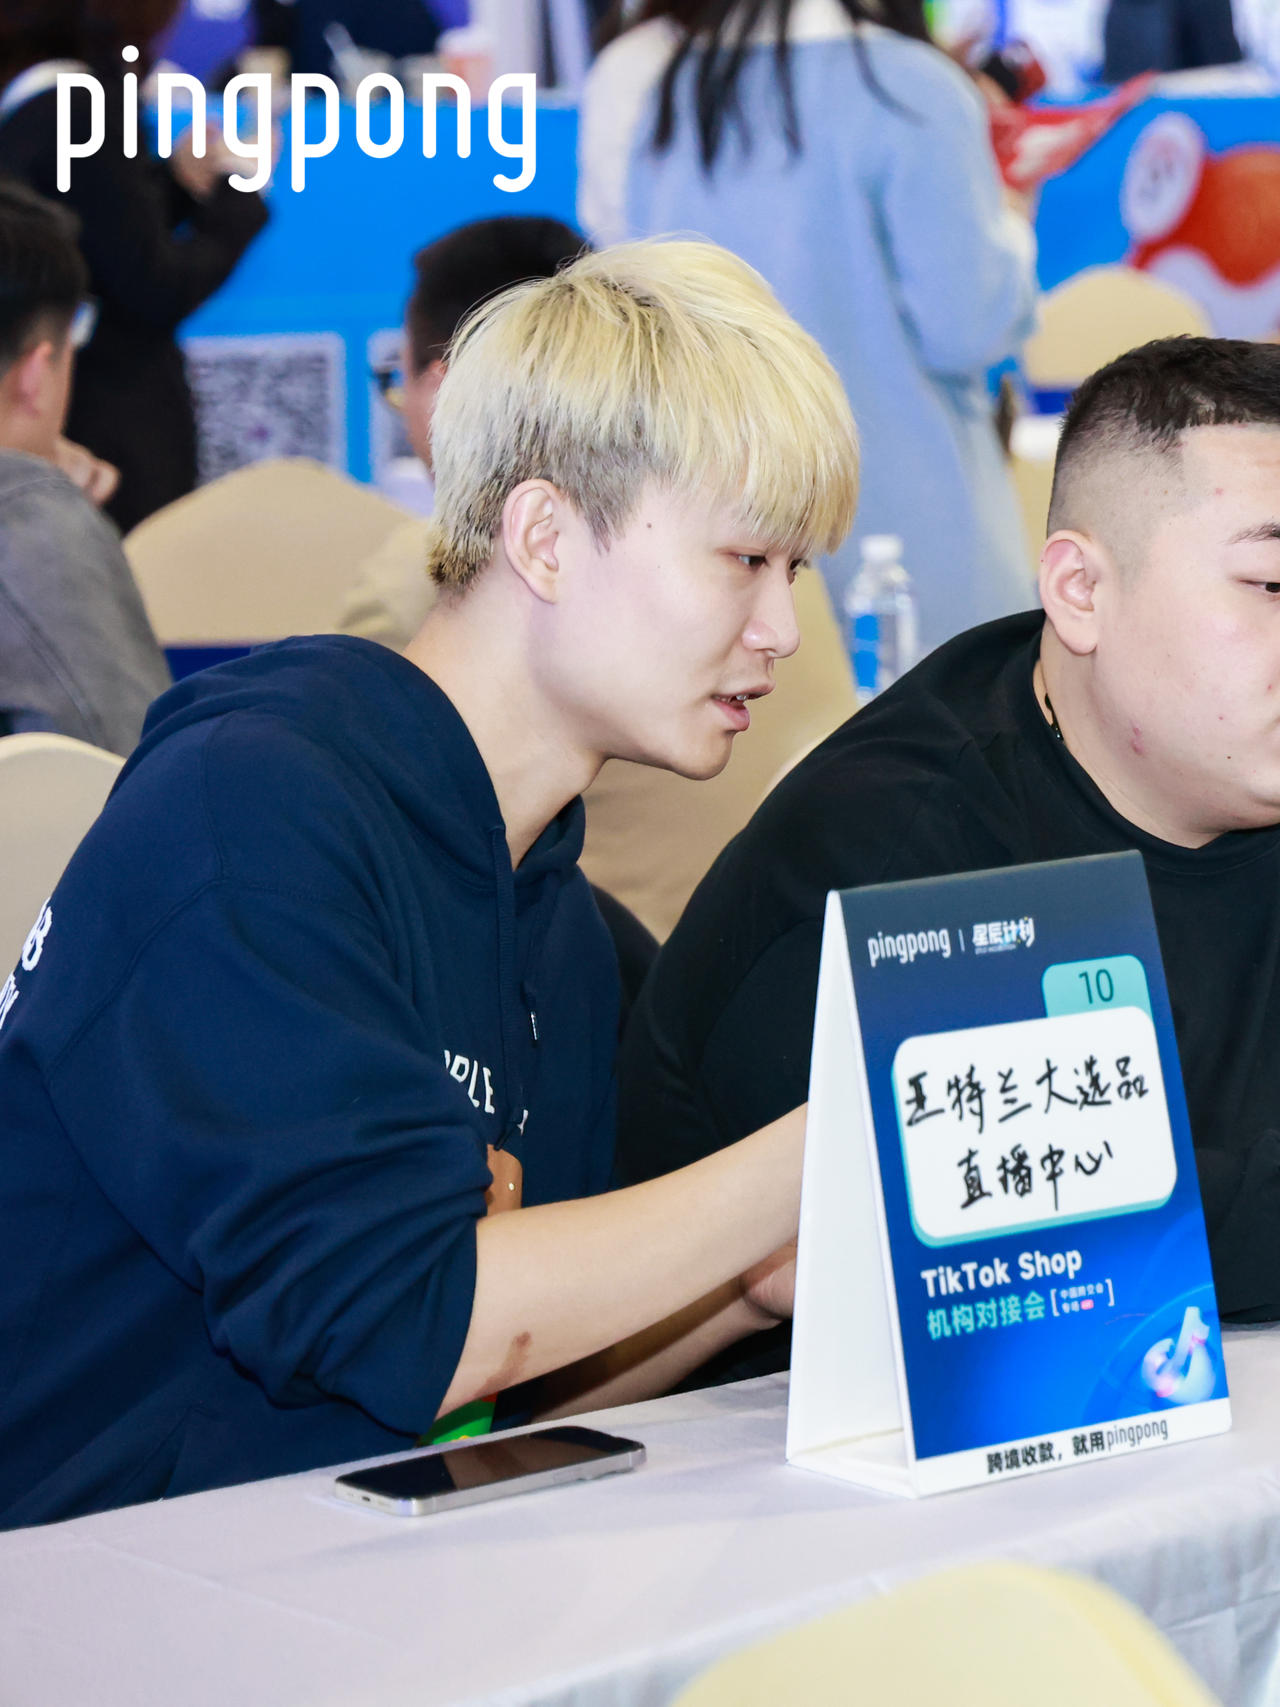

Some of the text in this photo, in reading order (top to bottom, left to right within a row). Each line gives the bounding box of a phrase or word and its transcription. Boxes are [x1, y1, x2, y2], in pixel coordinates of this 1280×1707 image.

[867, 928, 951, 968] pingpong
[1079, 969, 1114, 1004] 10
[957, 1140, 1113, 1212] 直播中心
[920, 1250, 1082, 1298] TikTok Shop
[927, 1290, 1046, 1340] 机构对接会
